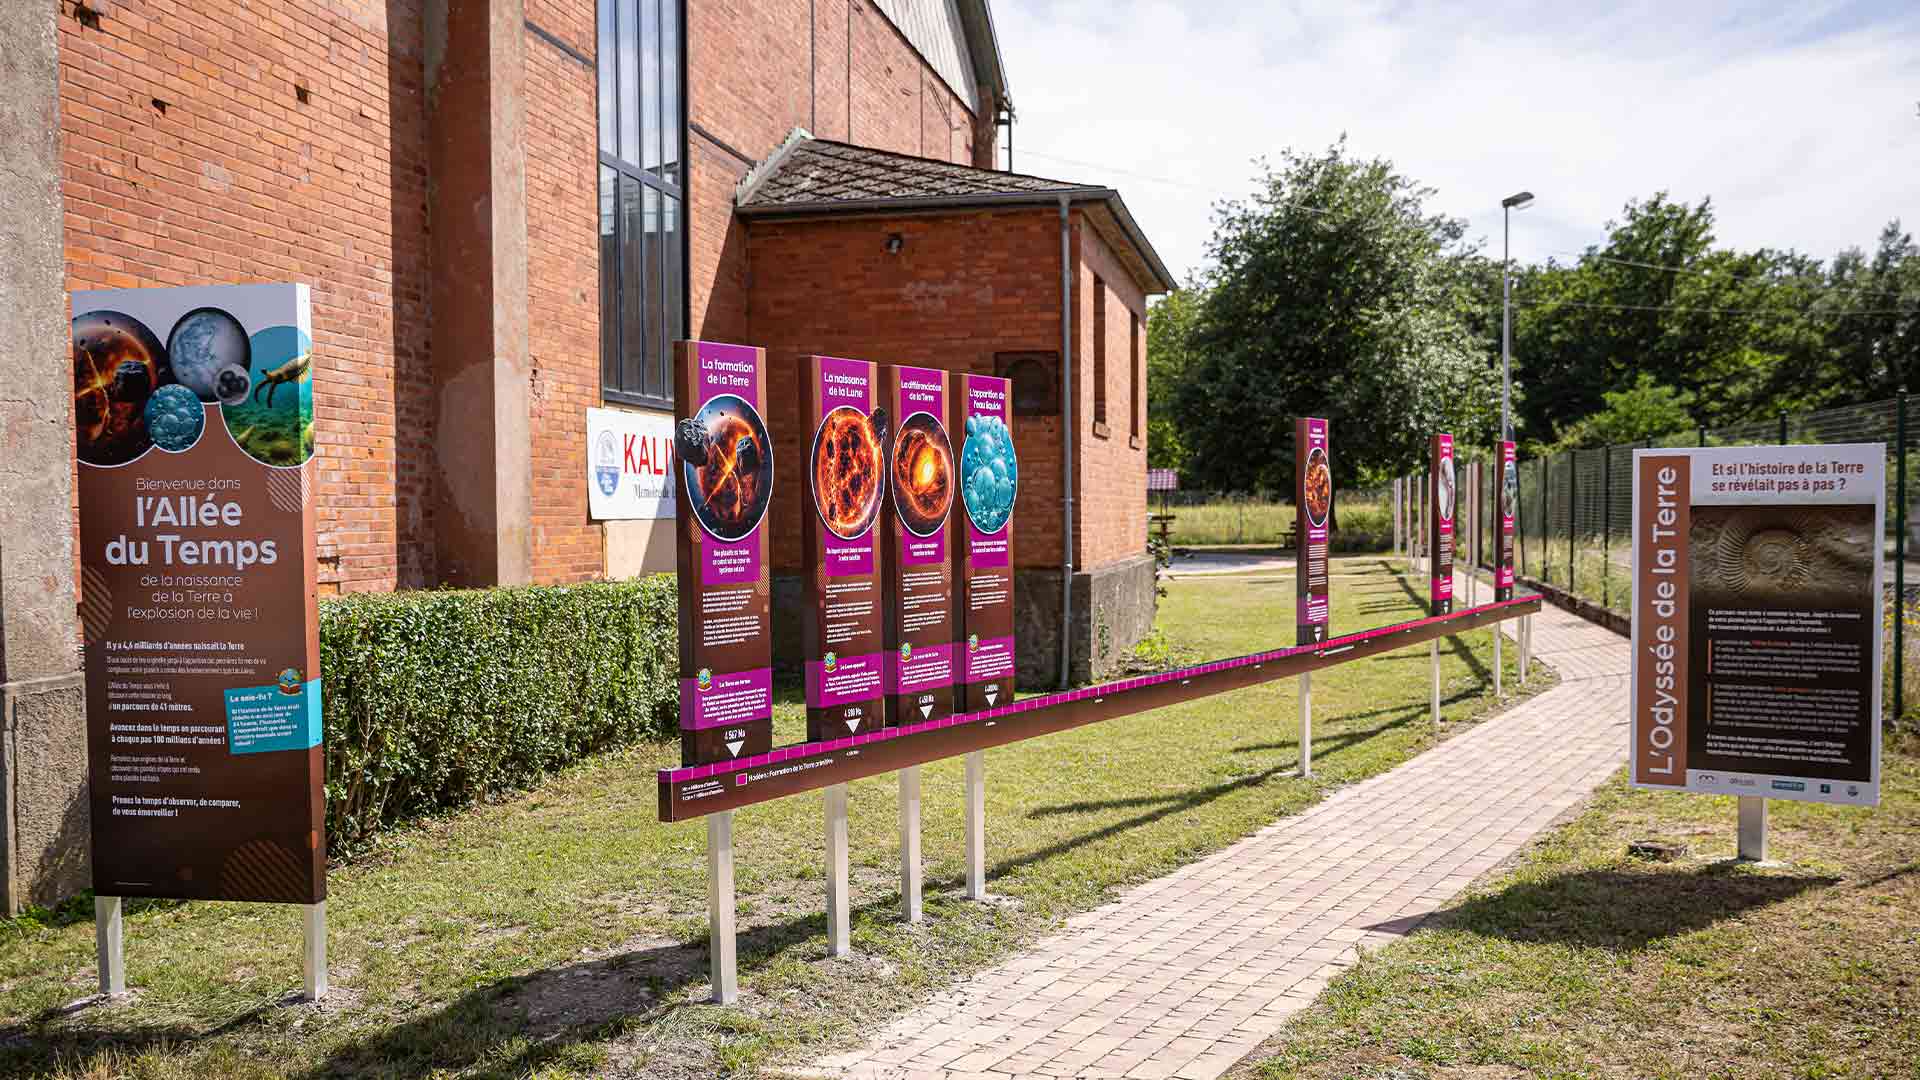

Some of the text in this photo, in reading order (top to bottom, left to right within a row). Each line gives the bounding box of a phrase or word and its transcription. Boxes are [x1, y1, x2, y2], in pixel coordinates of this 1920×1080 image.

[702, 358, 753, 373] La formation
[707, 373, 749, 387] de la Terre
[824, 371, 867, 386] La naissance
[829, 386, 863, 398] de la Lune
[1712, 461, 1864, 476] Et si l'histoire de la Terre
[136, 477, 241, 491] Bienvenue dans
[1712, 477, 1846, 494] se révélait pas à pas ?
[136, 493, 243, 527] l'Allée
[105, 535, 278, 570] du Temps
[141, 574, 242, 587] de la naissance
[152, 590, 233, 603] de la Terre à
[128, 606, 260, 621] l'explosion de la vie !
[1649, 466, 1679, 775] L'Odyssée de la Terre
[228, 641, 244, 650] Terre
[122, 703, 149, 712] parcours
[150, 702, 159, 711] de
[160, 702, 167, 711] 41
[168, 702, 193, 711] mètres.
[111, 723, 135, 731] Avancez
[137, 723, 152, 732] dans
[153, 723, 159, 731] le
[160, 724, 180, 733] temps
[190, 724, 224, 734] parcourant
[117, 735, 139, 744] chaque
[141, 736, 152, 744] pas
[166, 735, 191, 744] millions
[192, 736, 221, 744] d'années
[142, 797, 161, 806] temps
[162, 797, 198, 807] d'observer,
[200, 797, 208, 806] de
[209, 798, 240, 809] comparer,
[113, 808, 121, 816] de
[122, 808, 136, 816] vous
[137, 808, 174, 817] émerveiller
